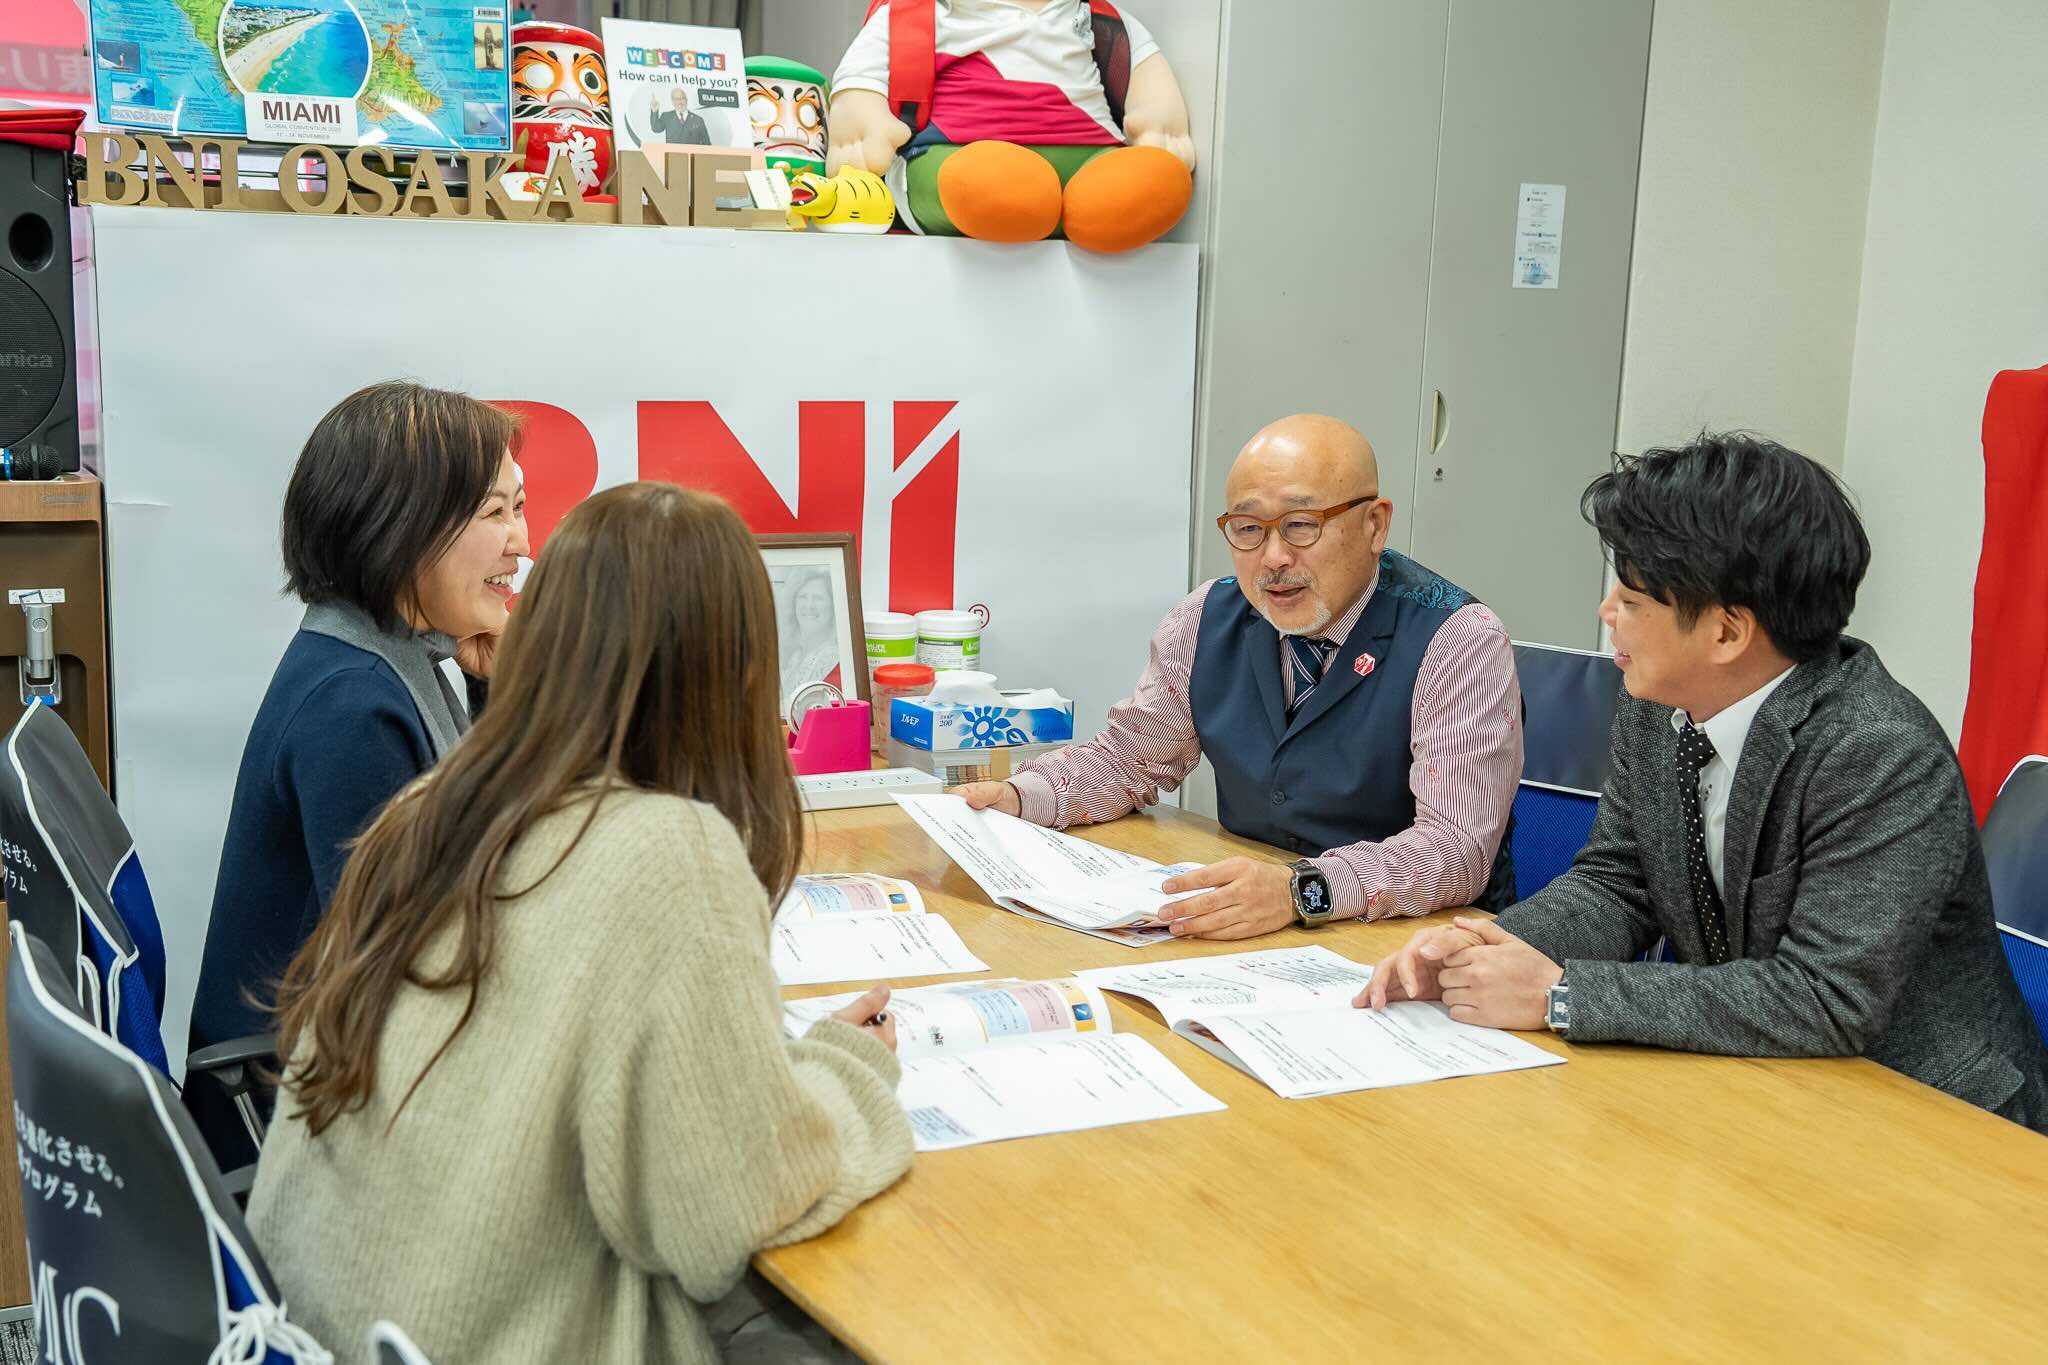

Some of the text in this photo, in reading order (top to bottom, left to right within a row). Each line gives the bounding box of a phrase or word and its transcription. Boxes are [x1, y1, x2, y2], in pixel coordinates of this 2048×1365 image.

[627, 48, 724, 70] WELCOME
[619, 70, 645, 81] How
[649, 74, 670, 83] can
[681, 74, 706, 87] help
[710, 78, 739, 89] you?
[262, 100, 341, 124] MIAMI
[83, 131, 249, 209] BNI
[279, 144, 587, 221] OSAKA
[938, 719, 953, 727] 200
